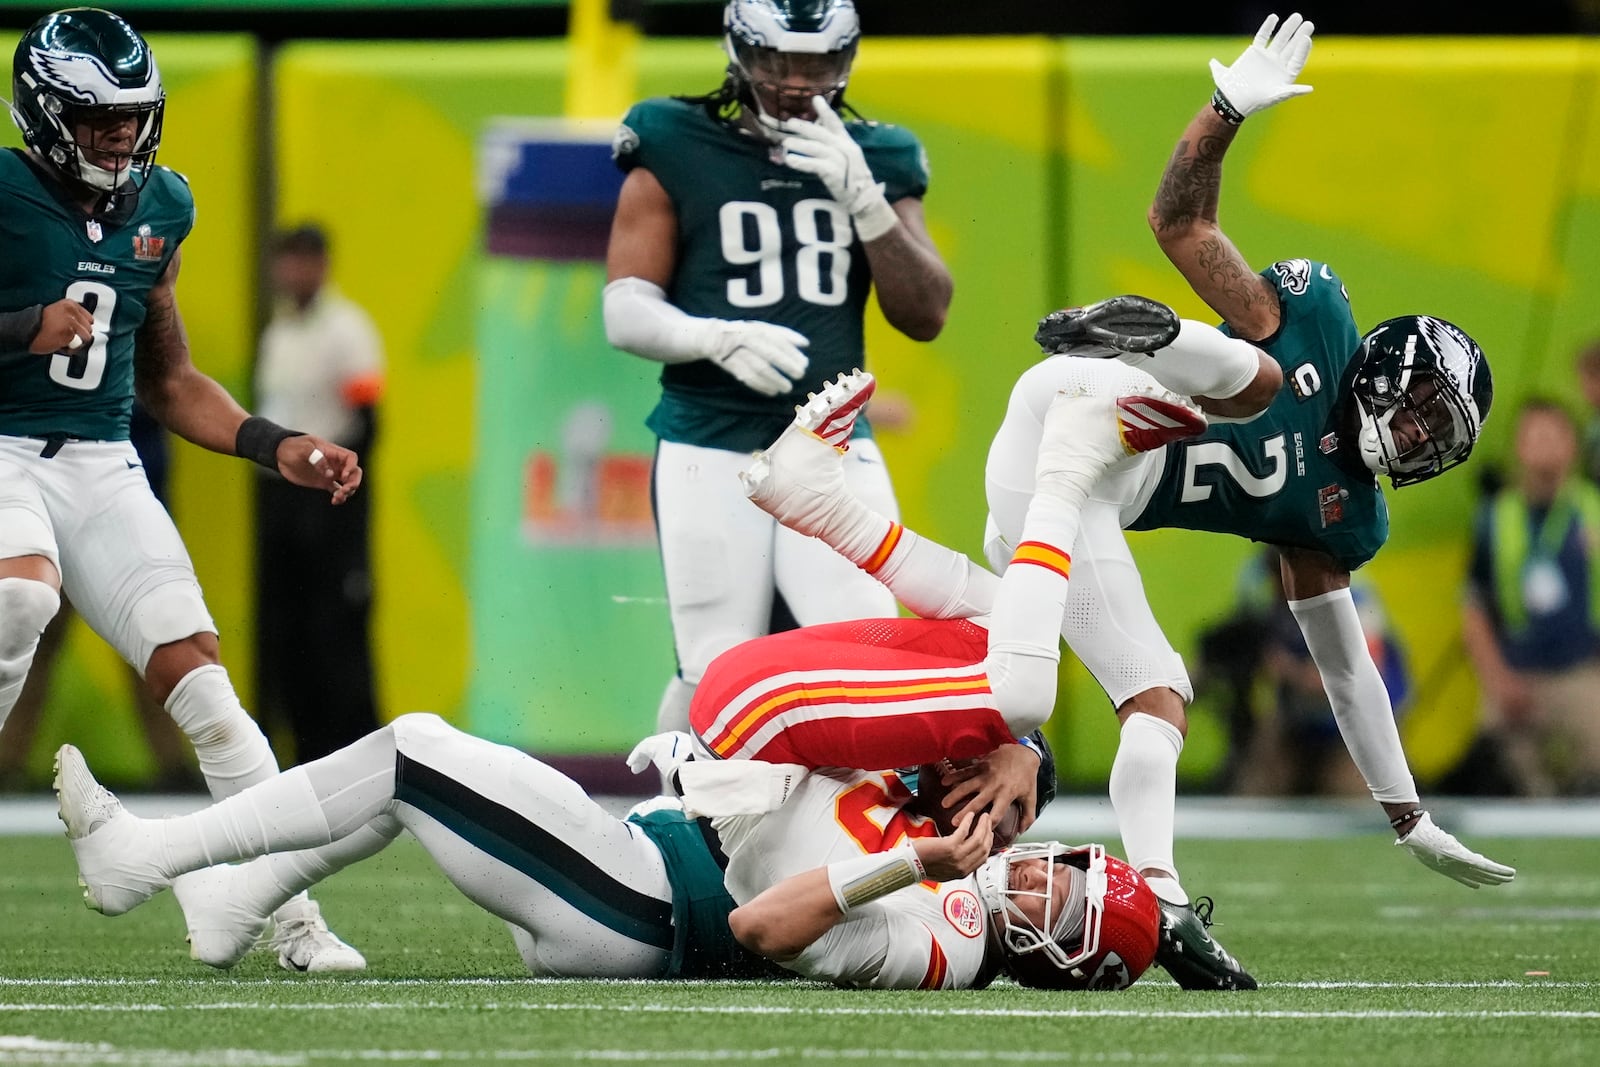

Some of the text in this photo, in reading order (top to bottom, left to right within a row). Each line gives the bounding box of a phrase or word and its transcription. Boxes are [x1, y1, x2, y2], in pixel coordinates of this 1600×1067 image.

[77, 261, 116, 274] EAGLES
[719, 198, 853, 308] 98
[49, 280, 117, 391] 3
[1295, 363, 1321, 396] C
[1181, 435, 1287, 503] 2
[1294, 432, 1305, 476] EAGLES
